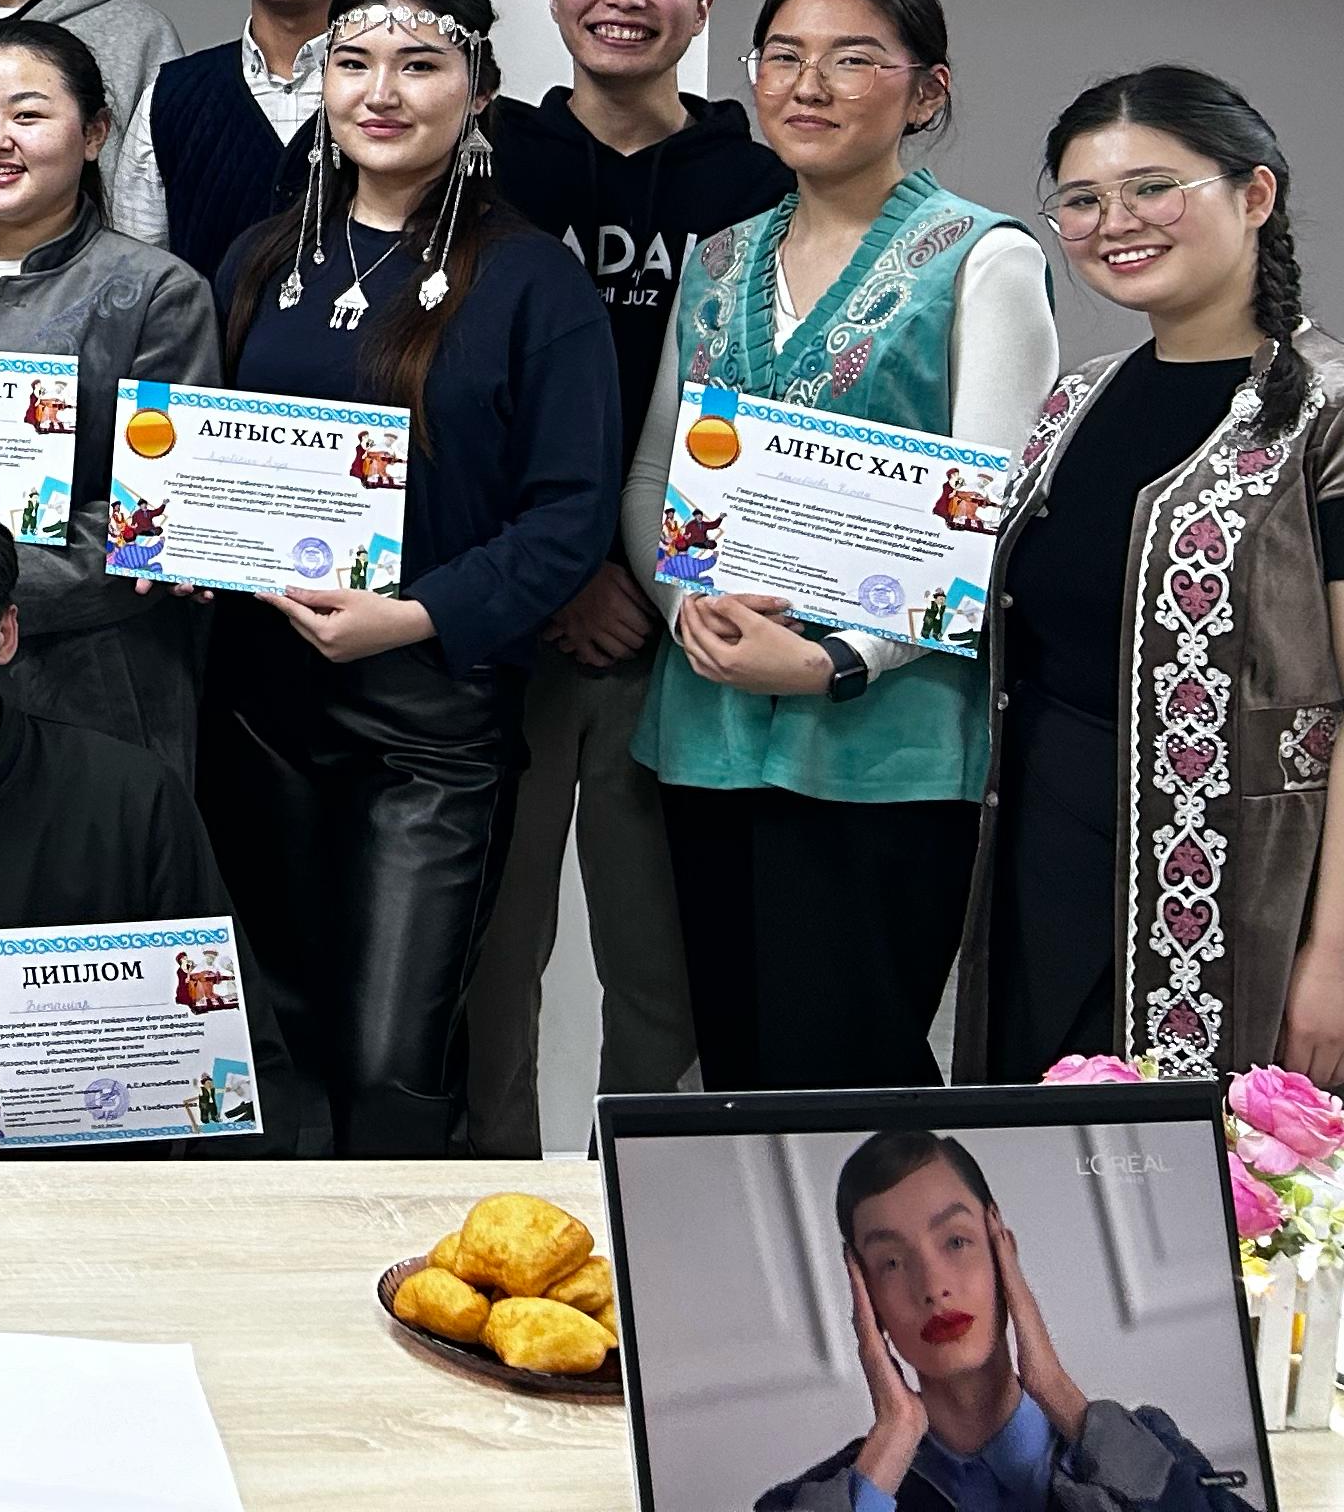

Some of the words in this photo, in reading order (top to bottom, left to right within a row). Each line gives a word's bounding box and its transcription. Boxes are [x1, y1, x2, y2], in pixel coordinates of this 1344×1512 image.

[622, 289, 659, 306] JUZ
[198, 419, 286, 445] АЛҒЫС
[292, 428, 344, 451] ХАТ
[764, 434, 863, 471] АЛҒЫС
[867, 455, 929, 486] ХАТ
[22, 960, 144, 989] ДИПЛОМ
